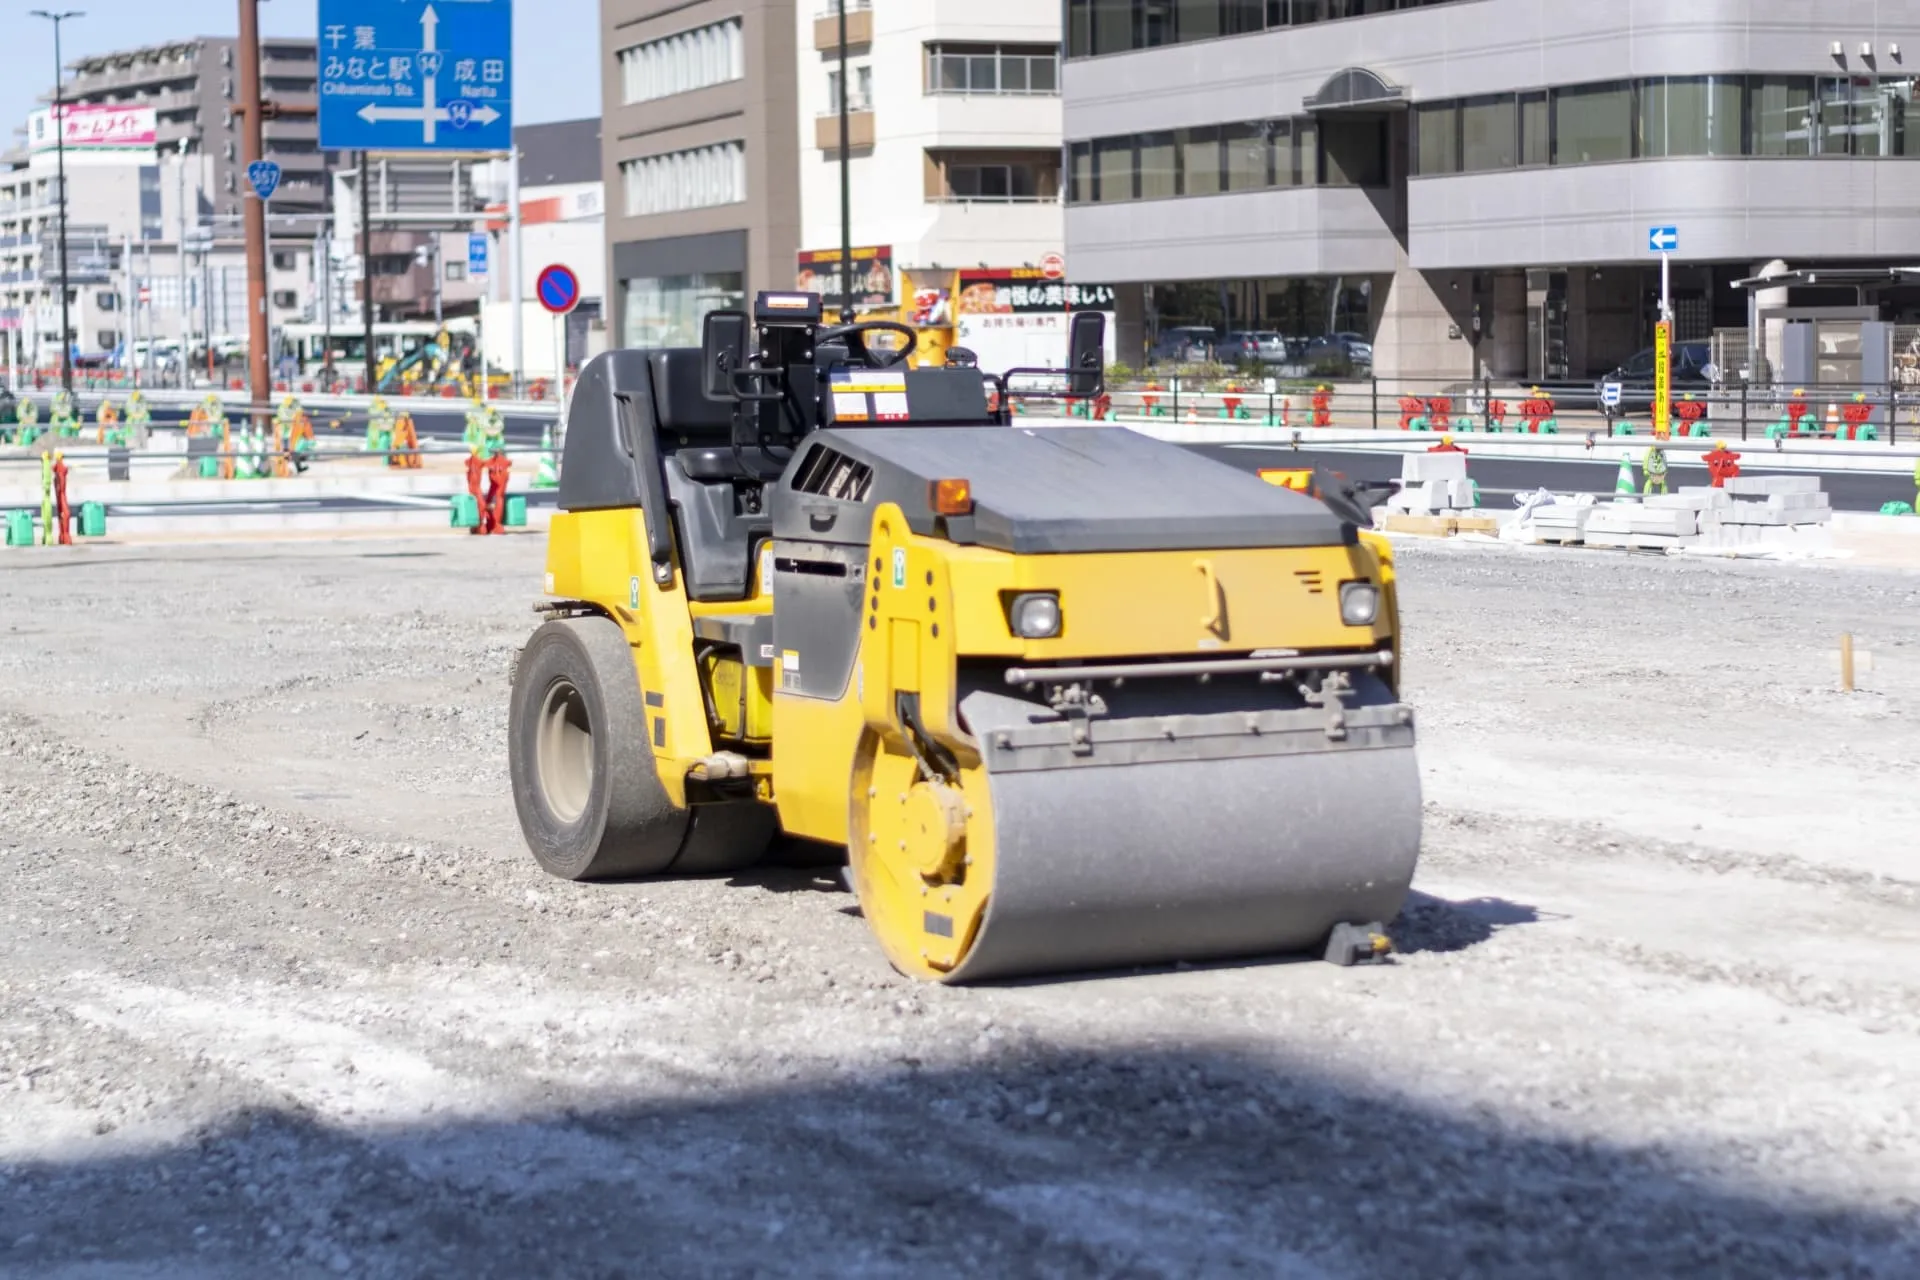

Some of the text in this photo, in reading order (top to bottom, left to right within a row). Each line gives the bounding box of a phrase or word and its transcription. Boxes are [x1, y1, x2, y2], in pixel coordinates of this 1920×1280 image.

[324, 24, 377, 50] 千葉
[324, 55, 412, 81] みなと駅
[420, 56, 437, 68] 14
[454, 58, 504, 83] 成田
[451, 105, 467, 118] 14
[251, 170, 278, 185] 357
